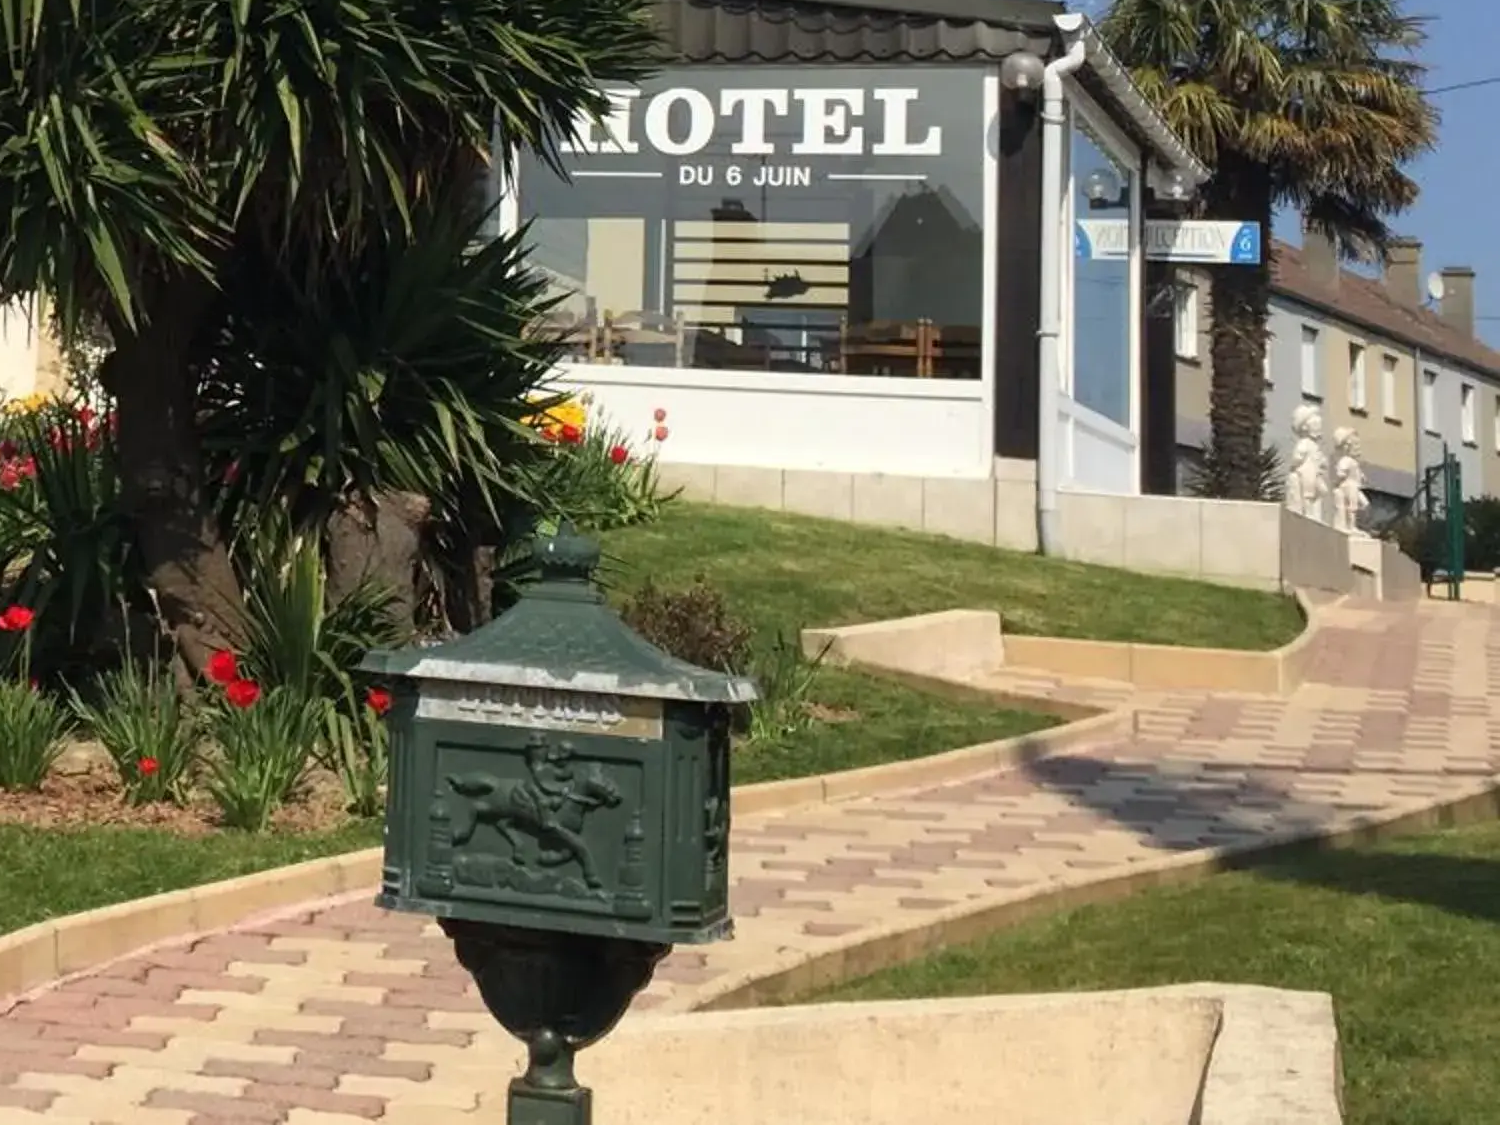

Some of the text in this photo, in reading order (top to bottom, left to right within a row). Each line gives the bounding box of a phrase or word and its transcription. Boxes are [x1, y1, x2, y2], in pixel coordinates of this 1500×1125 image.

[559, 86, 942, 156] HOTEL
[678, 165, 811, 186] DU 6 JUIN
